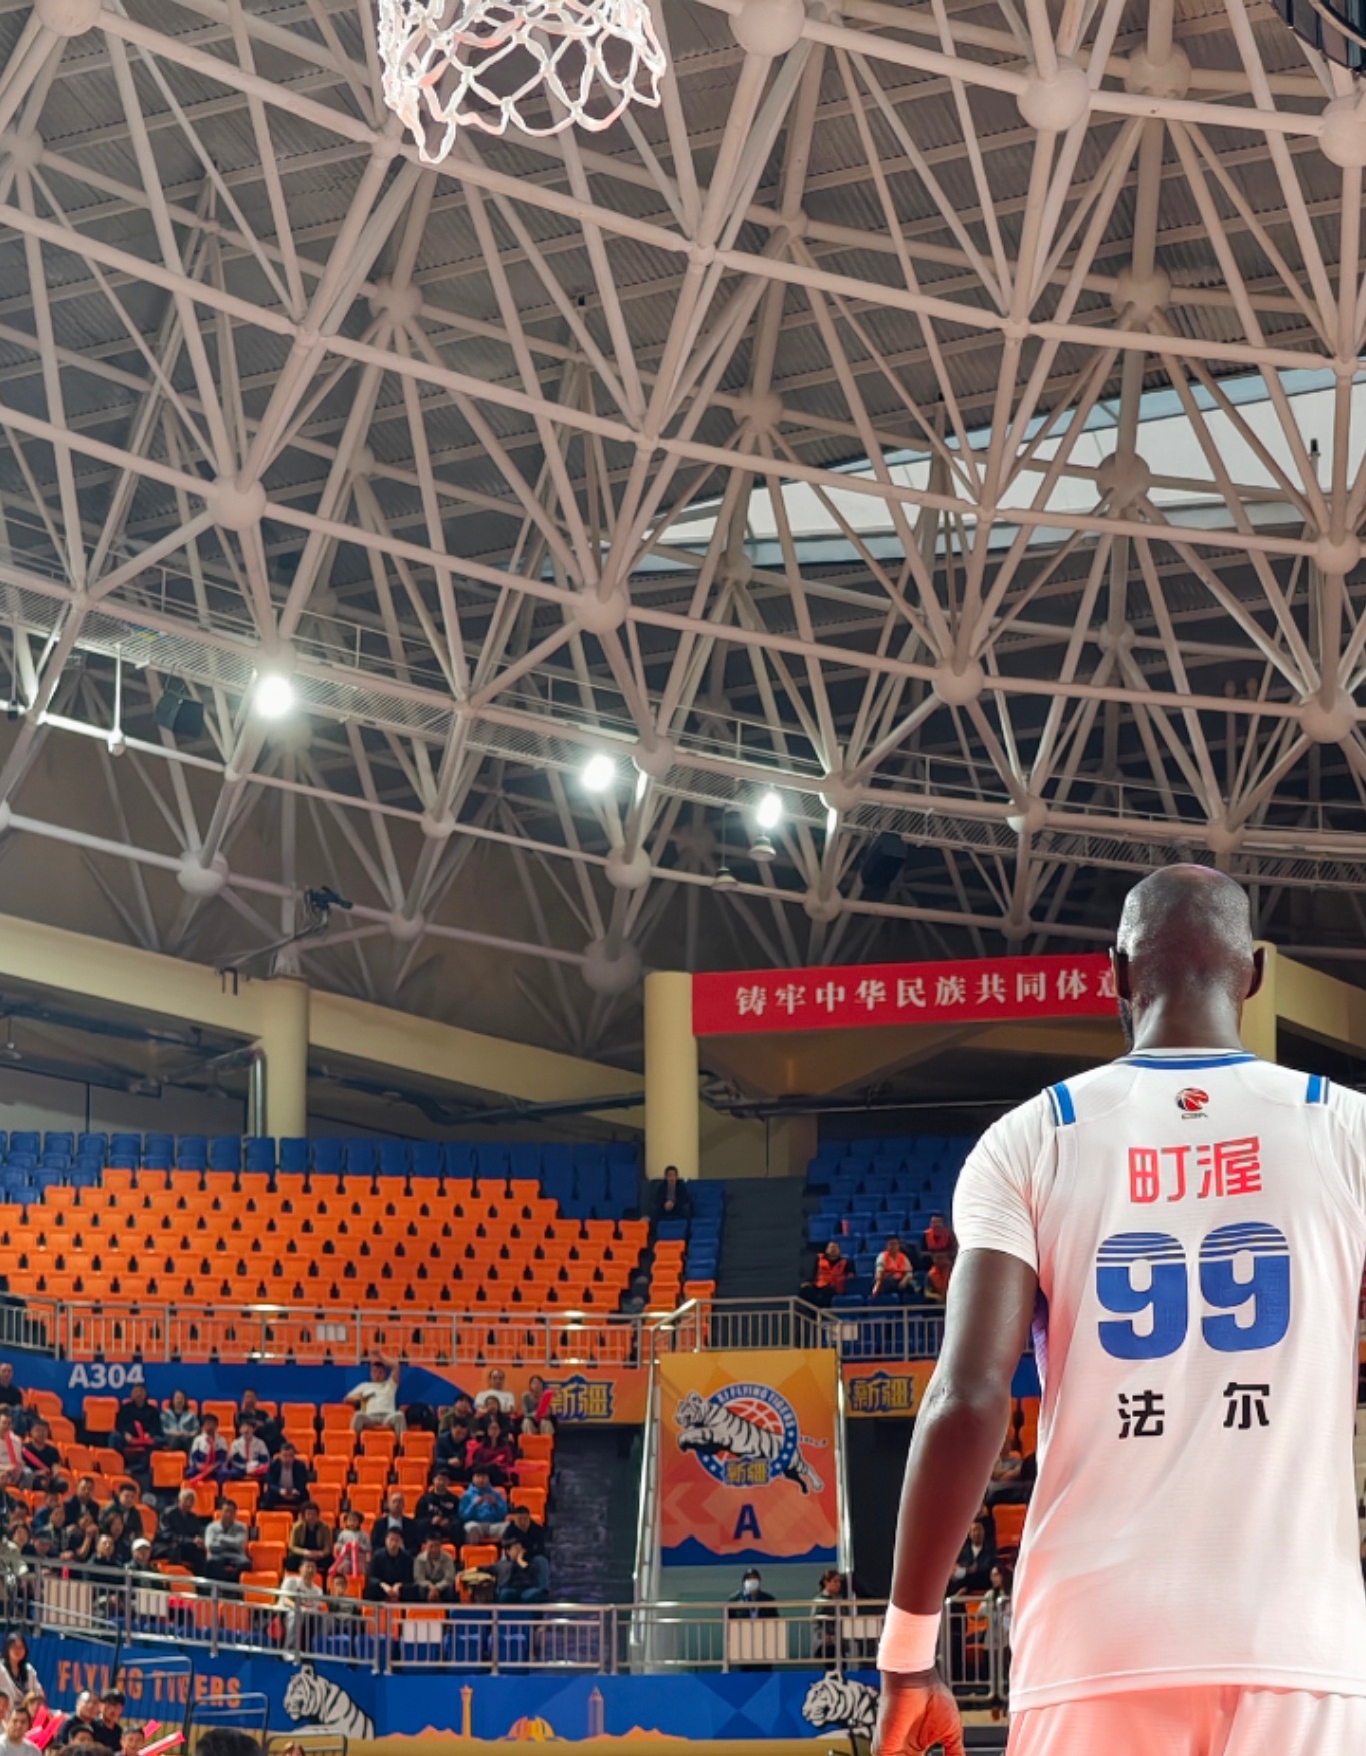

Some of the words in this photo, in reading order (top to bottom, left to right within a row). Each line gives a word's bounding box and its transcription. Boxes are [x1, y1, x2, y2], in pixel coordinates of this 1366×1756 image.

[1128, 1136, 1262, 1204] 町渥
[1096, 1221, 1291, 1361] 99
[68, 1364, 145, 1389] A304
[729, 1385, 769, 1399] FLYING
[766, 1389, 796, 1430] TIGERS
[1117, 1381, 1271, 1440] 法尔
[733, 1503, 762, 1540] A
[153, 1669, 242, 1709] TIGERS
